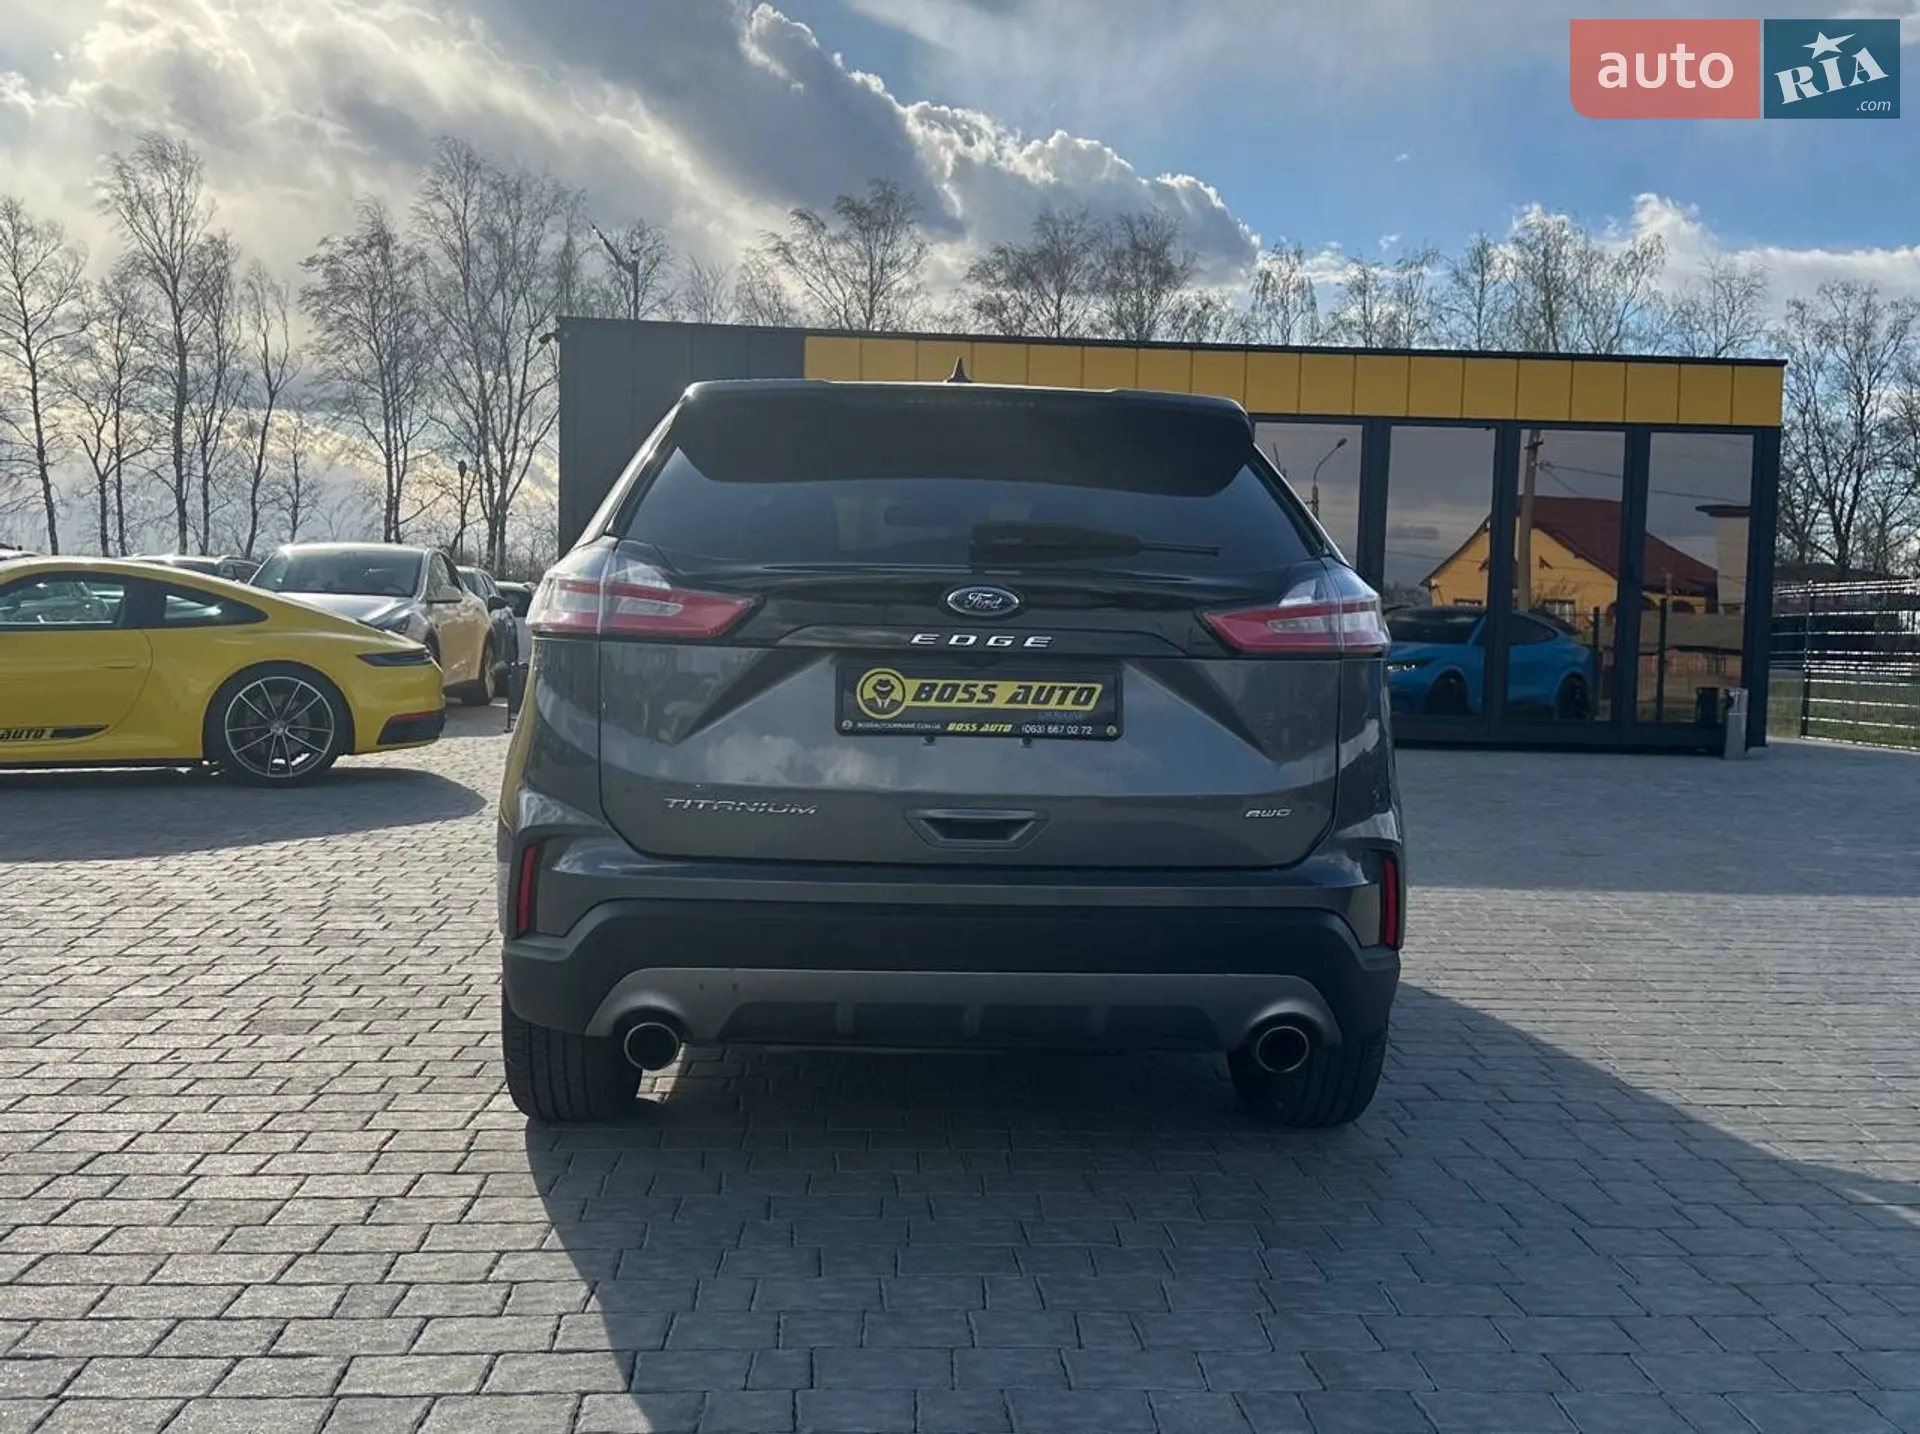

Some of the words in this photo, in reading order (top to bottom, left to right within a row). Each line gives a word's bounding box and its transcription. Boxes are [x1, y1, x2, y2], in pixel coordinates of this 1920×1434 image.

[964, 592, 1003, 610] Ford
[911, 633, 1053, 648] EDGE
[911, 682, 998, 704] BOSS
[1003, 684, 1097, 706] AUTO
[946, 722, 977, 732] BOSS
[979, 723, 1012, 733] AUTO
[664, 797, 819, 815] TITANIUM
